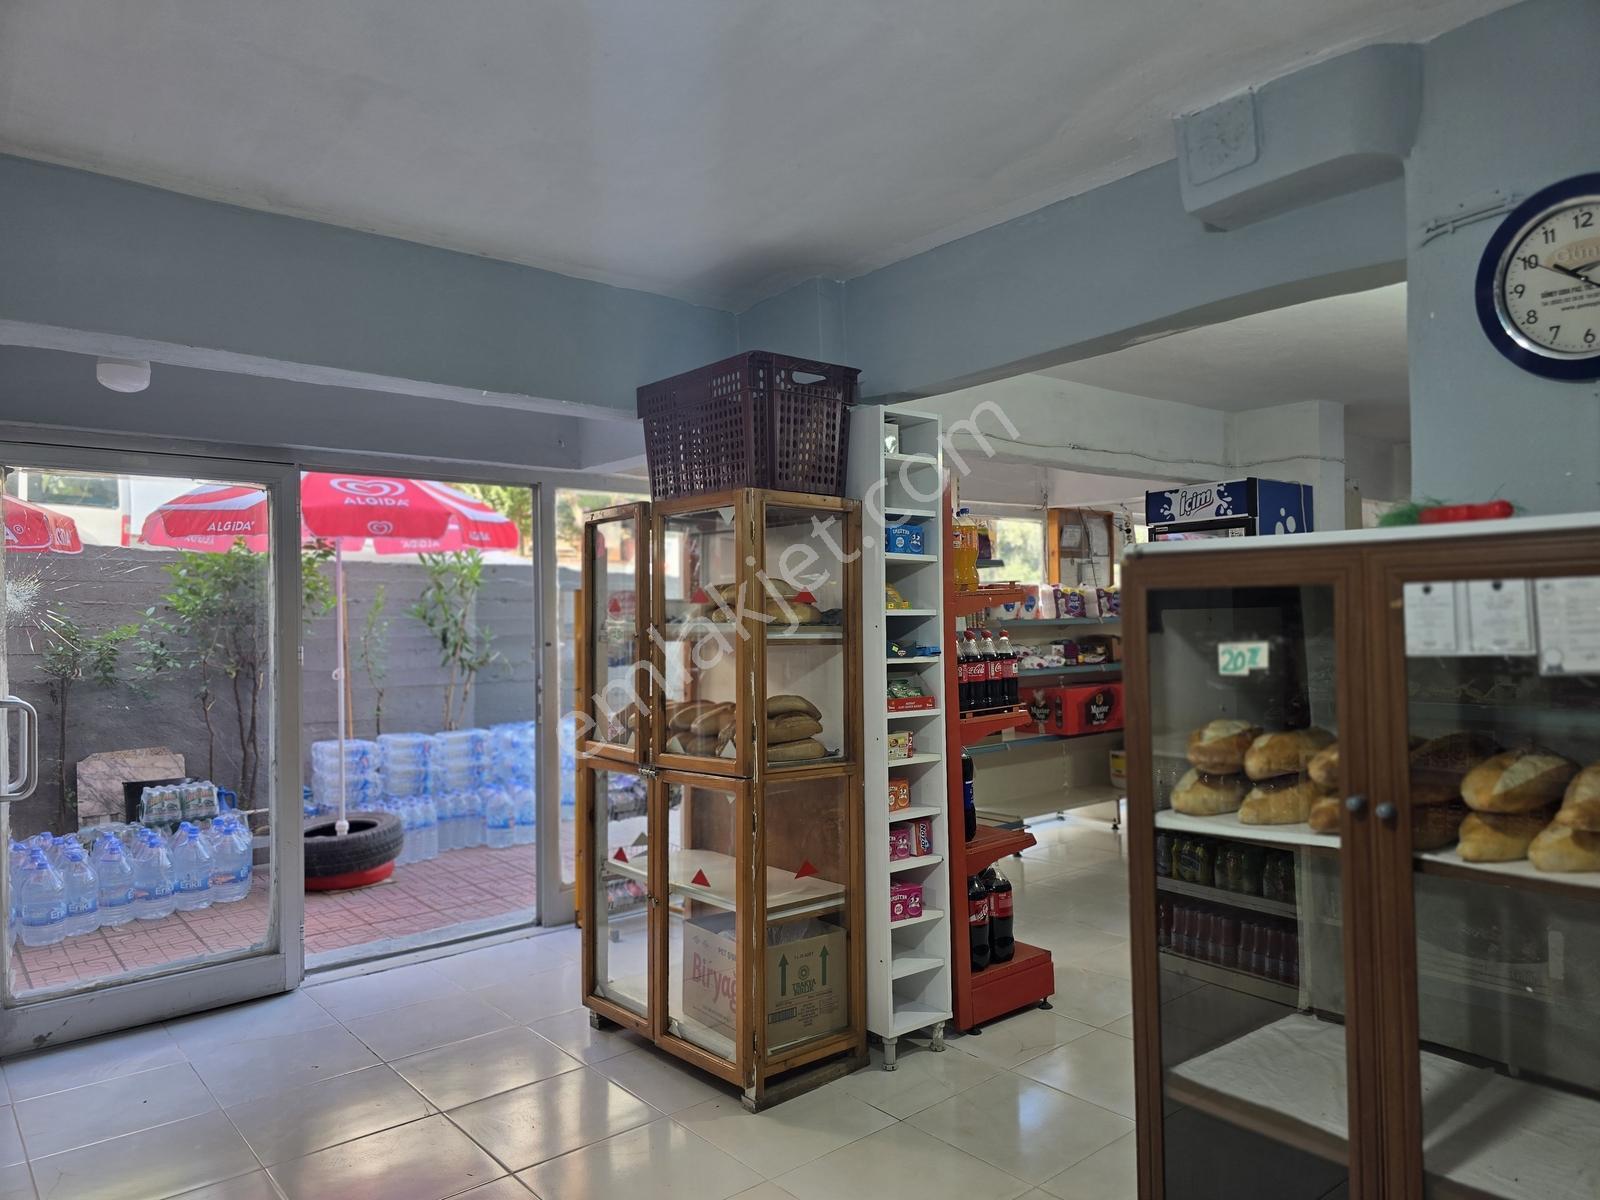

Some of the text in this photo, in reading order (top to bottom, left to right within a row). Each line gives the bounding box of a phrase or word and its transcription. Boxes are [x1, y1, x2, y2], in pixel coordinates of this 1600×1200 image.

[1573, 211, 1594, 229] 12
[1542, 228, 1556, 244] 11
[1521, 254, 1538, 270] 10
[1513, 283, 1526, 299] 9
[1526, 309, 1539, 325] 8
[1549, 325, 1561, 341] 7
[1583, 328, 1596, 344] 6
